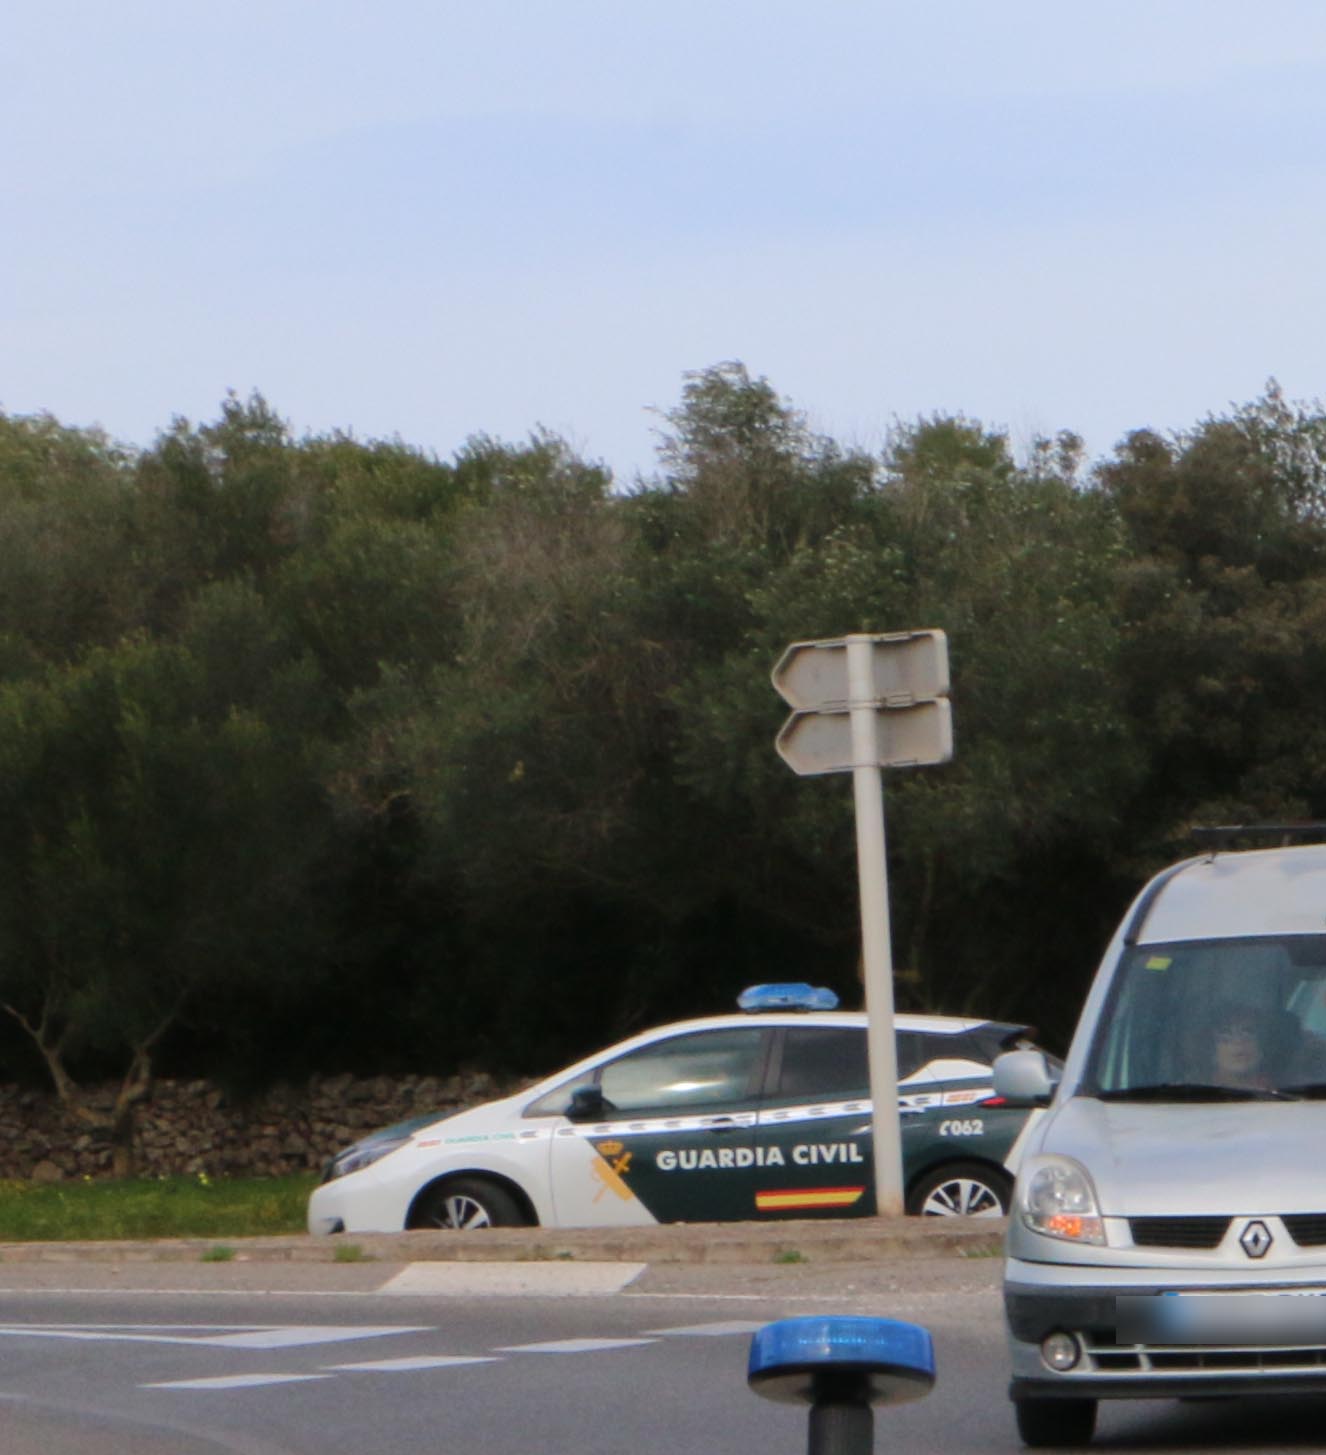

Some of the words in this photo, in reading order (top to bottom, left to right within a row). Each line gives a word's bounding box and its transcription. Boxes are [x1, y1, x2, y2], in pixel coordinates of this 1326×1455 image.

[950, 1119, 984, 1136] 062
[655, 1146, 785, 1171] GUARDIA
[792, 1143, 864, 1166] CIVIL
